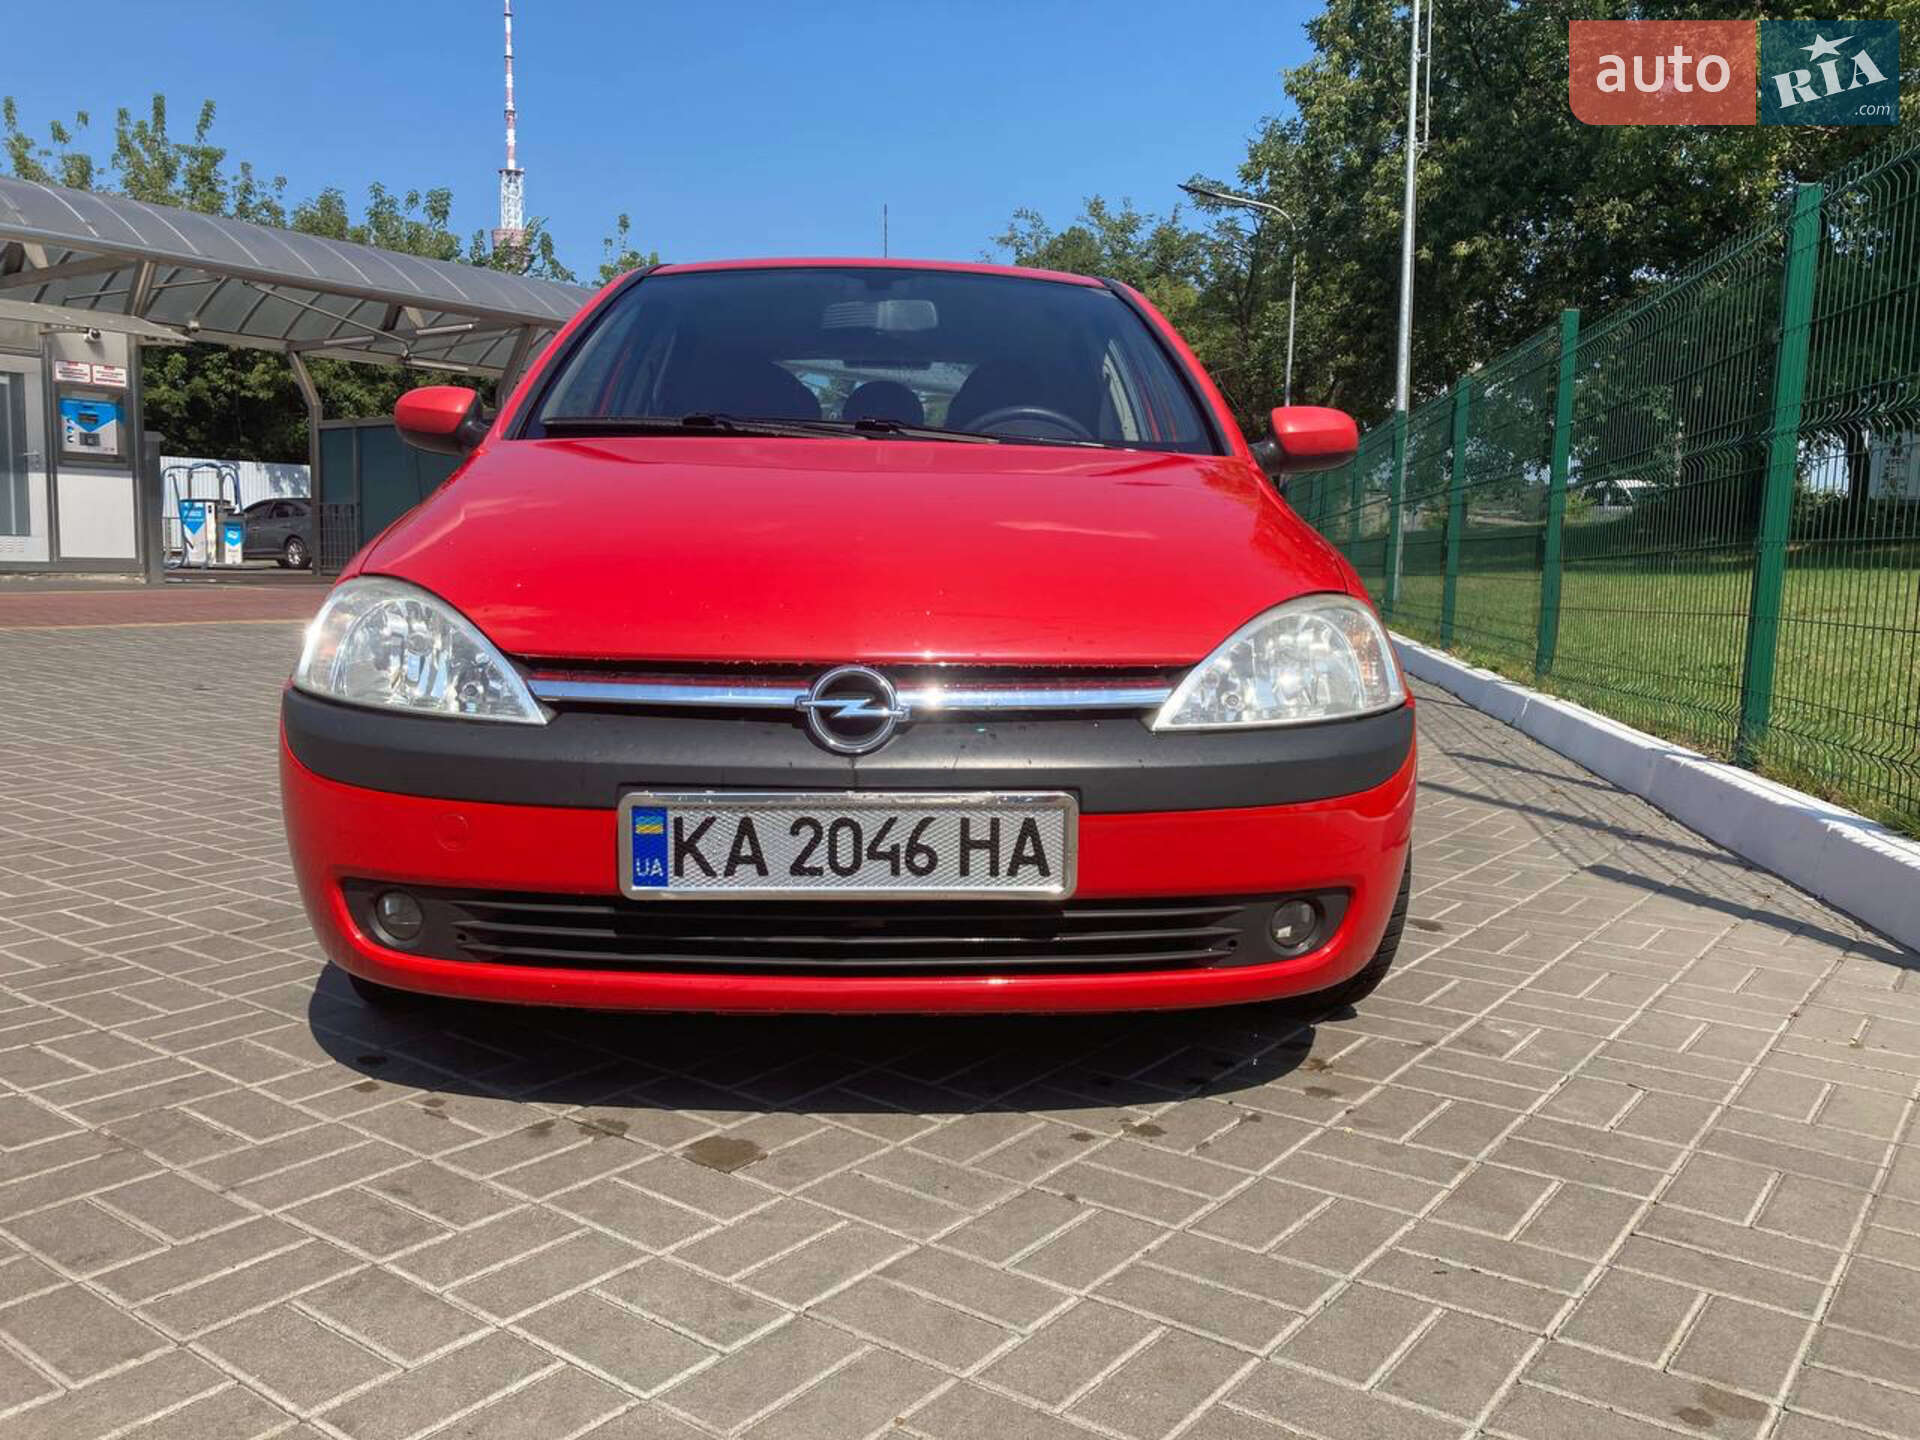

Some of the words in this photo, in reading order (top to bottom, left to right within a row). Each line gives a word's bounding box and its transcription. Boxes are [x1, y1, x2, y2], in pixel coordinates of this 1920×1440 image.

[672, 816, 768, 878] KA
[789, 816, 939, 878] 2046
[960, 816, 1051, 878] HA
[636, 859, 663, 877] UA
